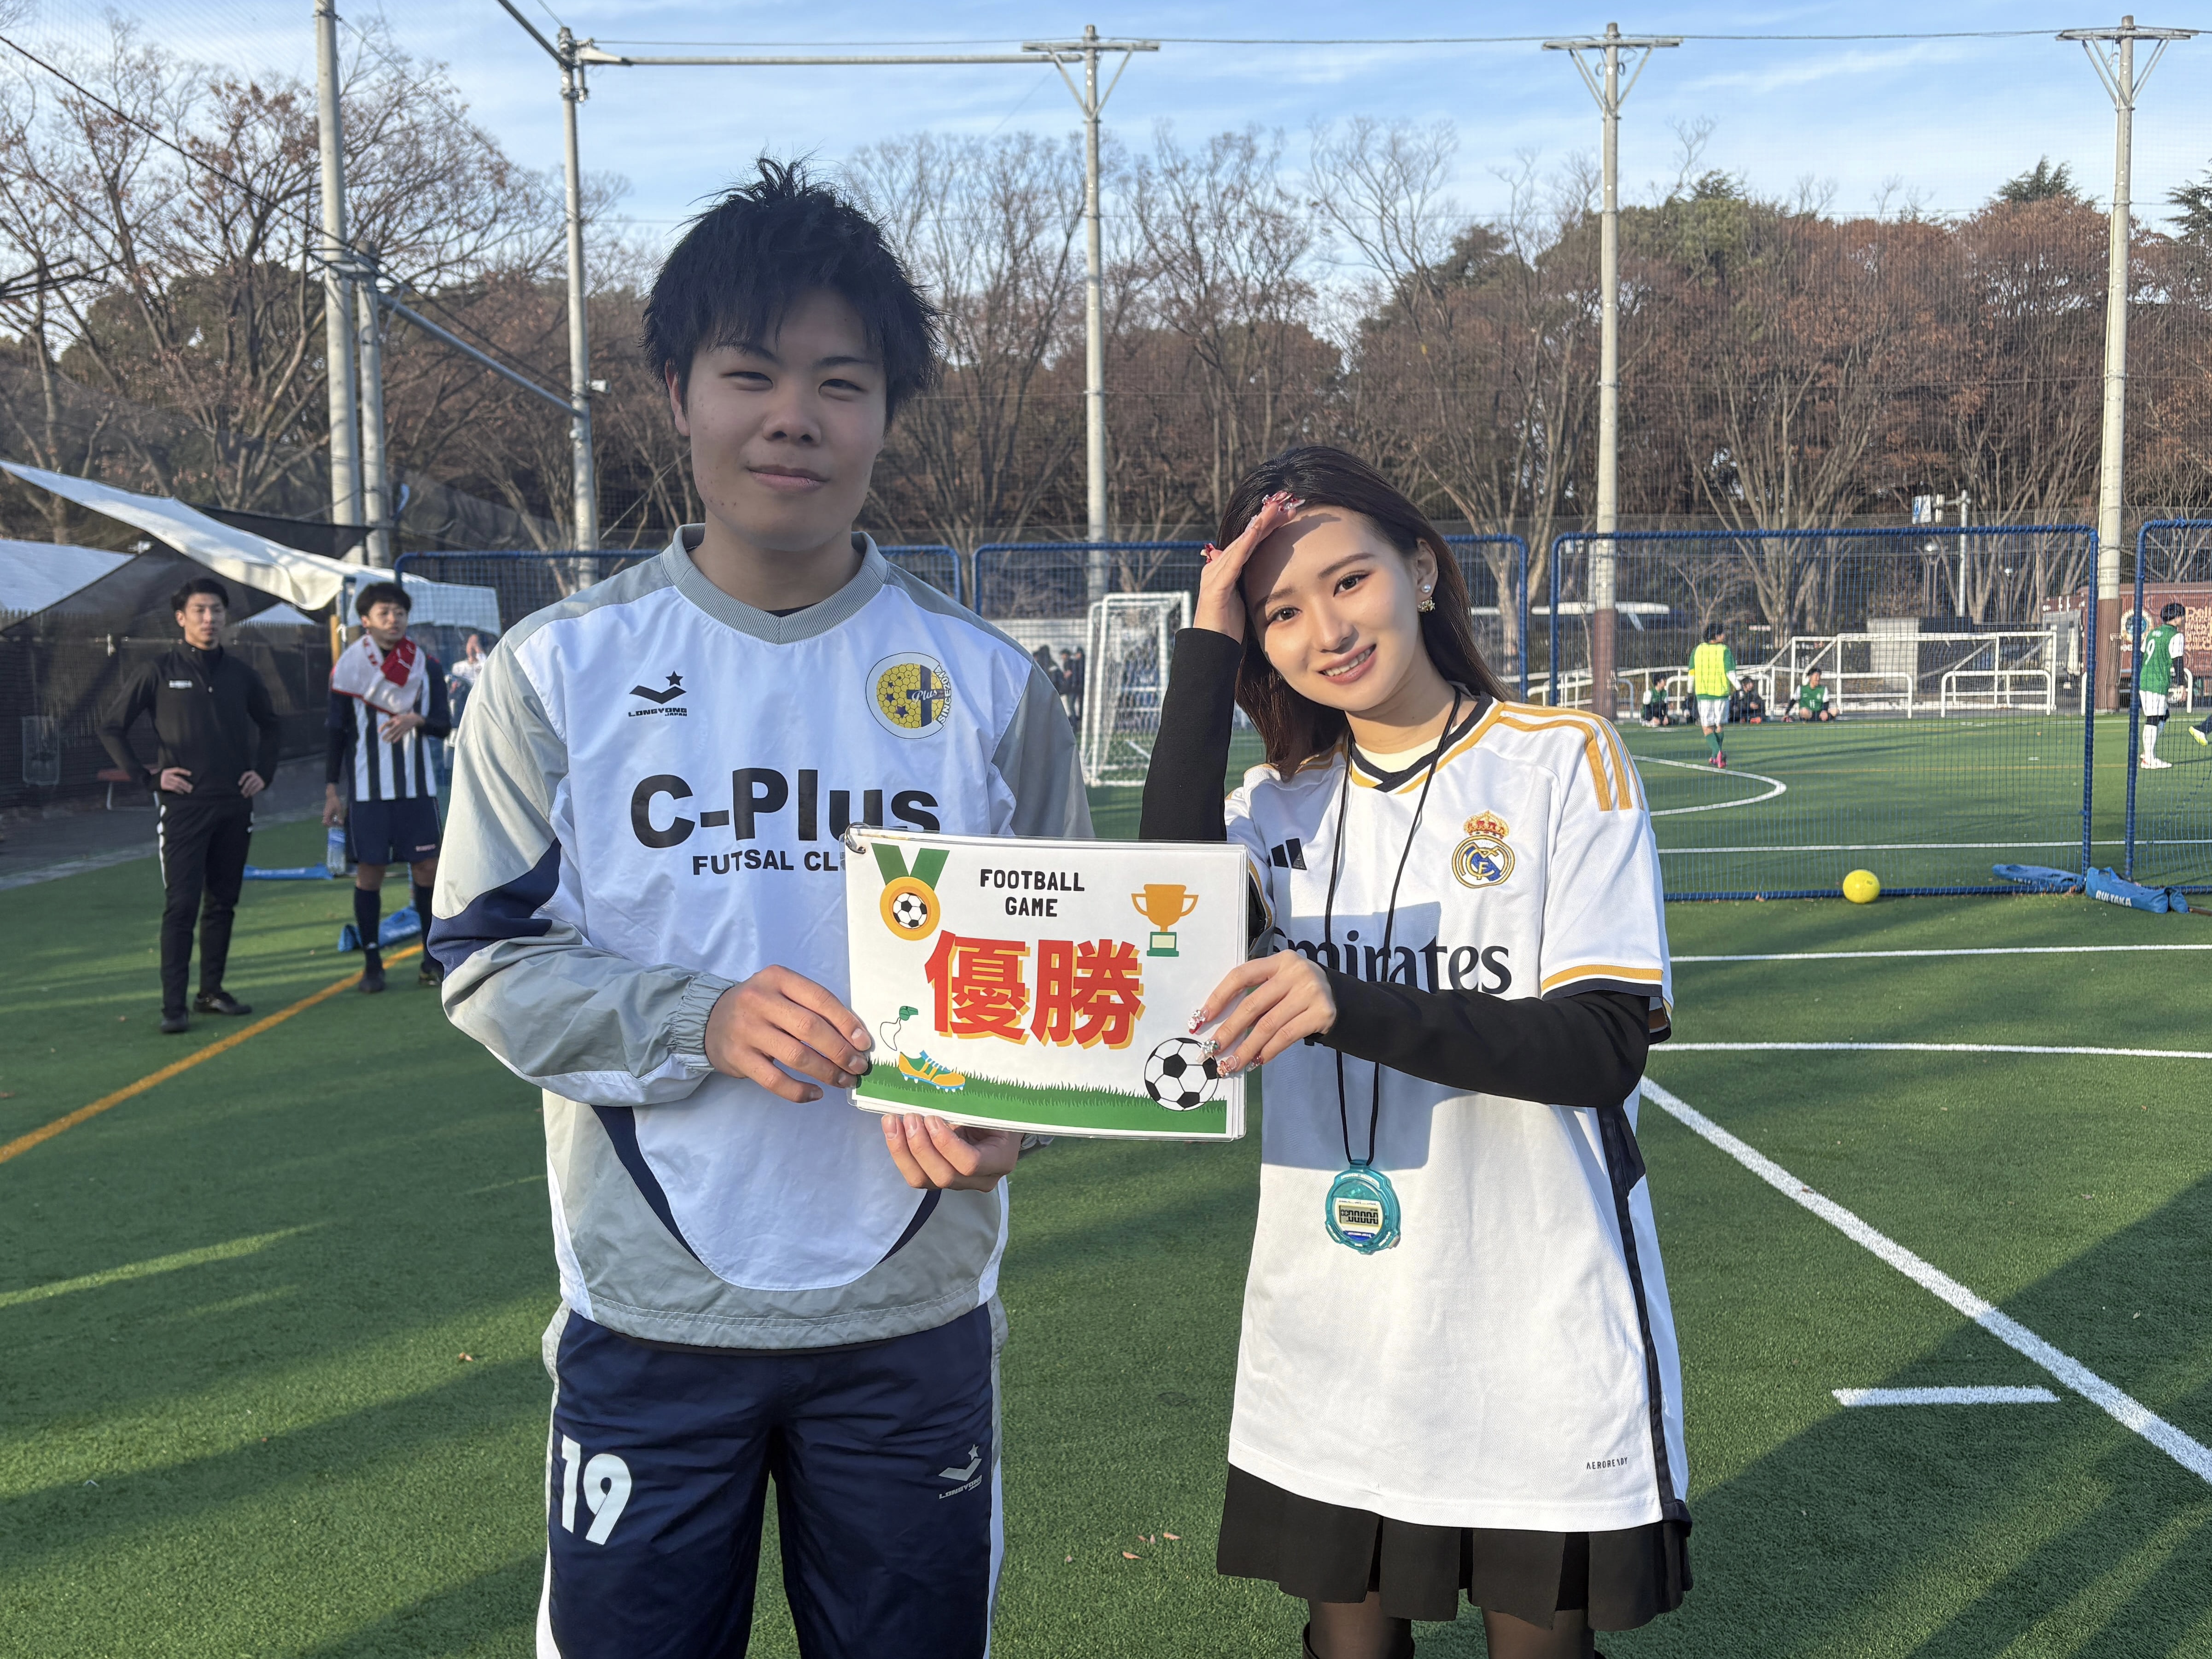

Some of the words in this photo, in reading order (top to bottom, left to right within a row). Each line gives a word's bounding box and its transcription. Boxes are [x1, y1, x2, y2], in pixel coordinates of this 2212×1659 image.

[2145, 638, 2155, 665] 9
[911, 689, 938, 703] Plus
[628, 707, 687, 717] LONGYONG
[631, 767, 940, 848] C-Plus
[692, 849, 794, 875] FUTSAL
[980, 869, 1085, 892] FOOTBALL
[1005, 896, 1058, 917] GAME
[924, 929, 1146, 1050] 優勝
[561, 1434, 632, 1545] 19
